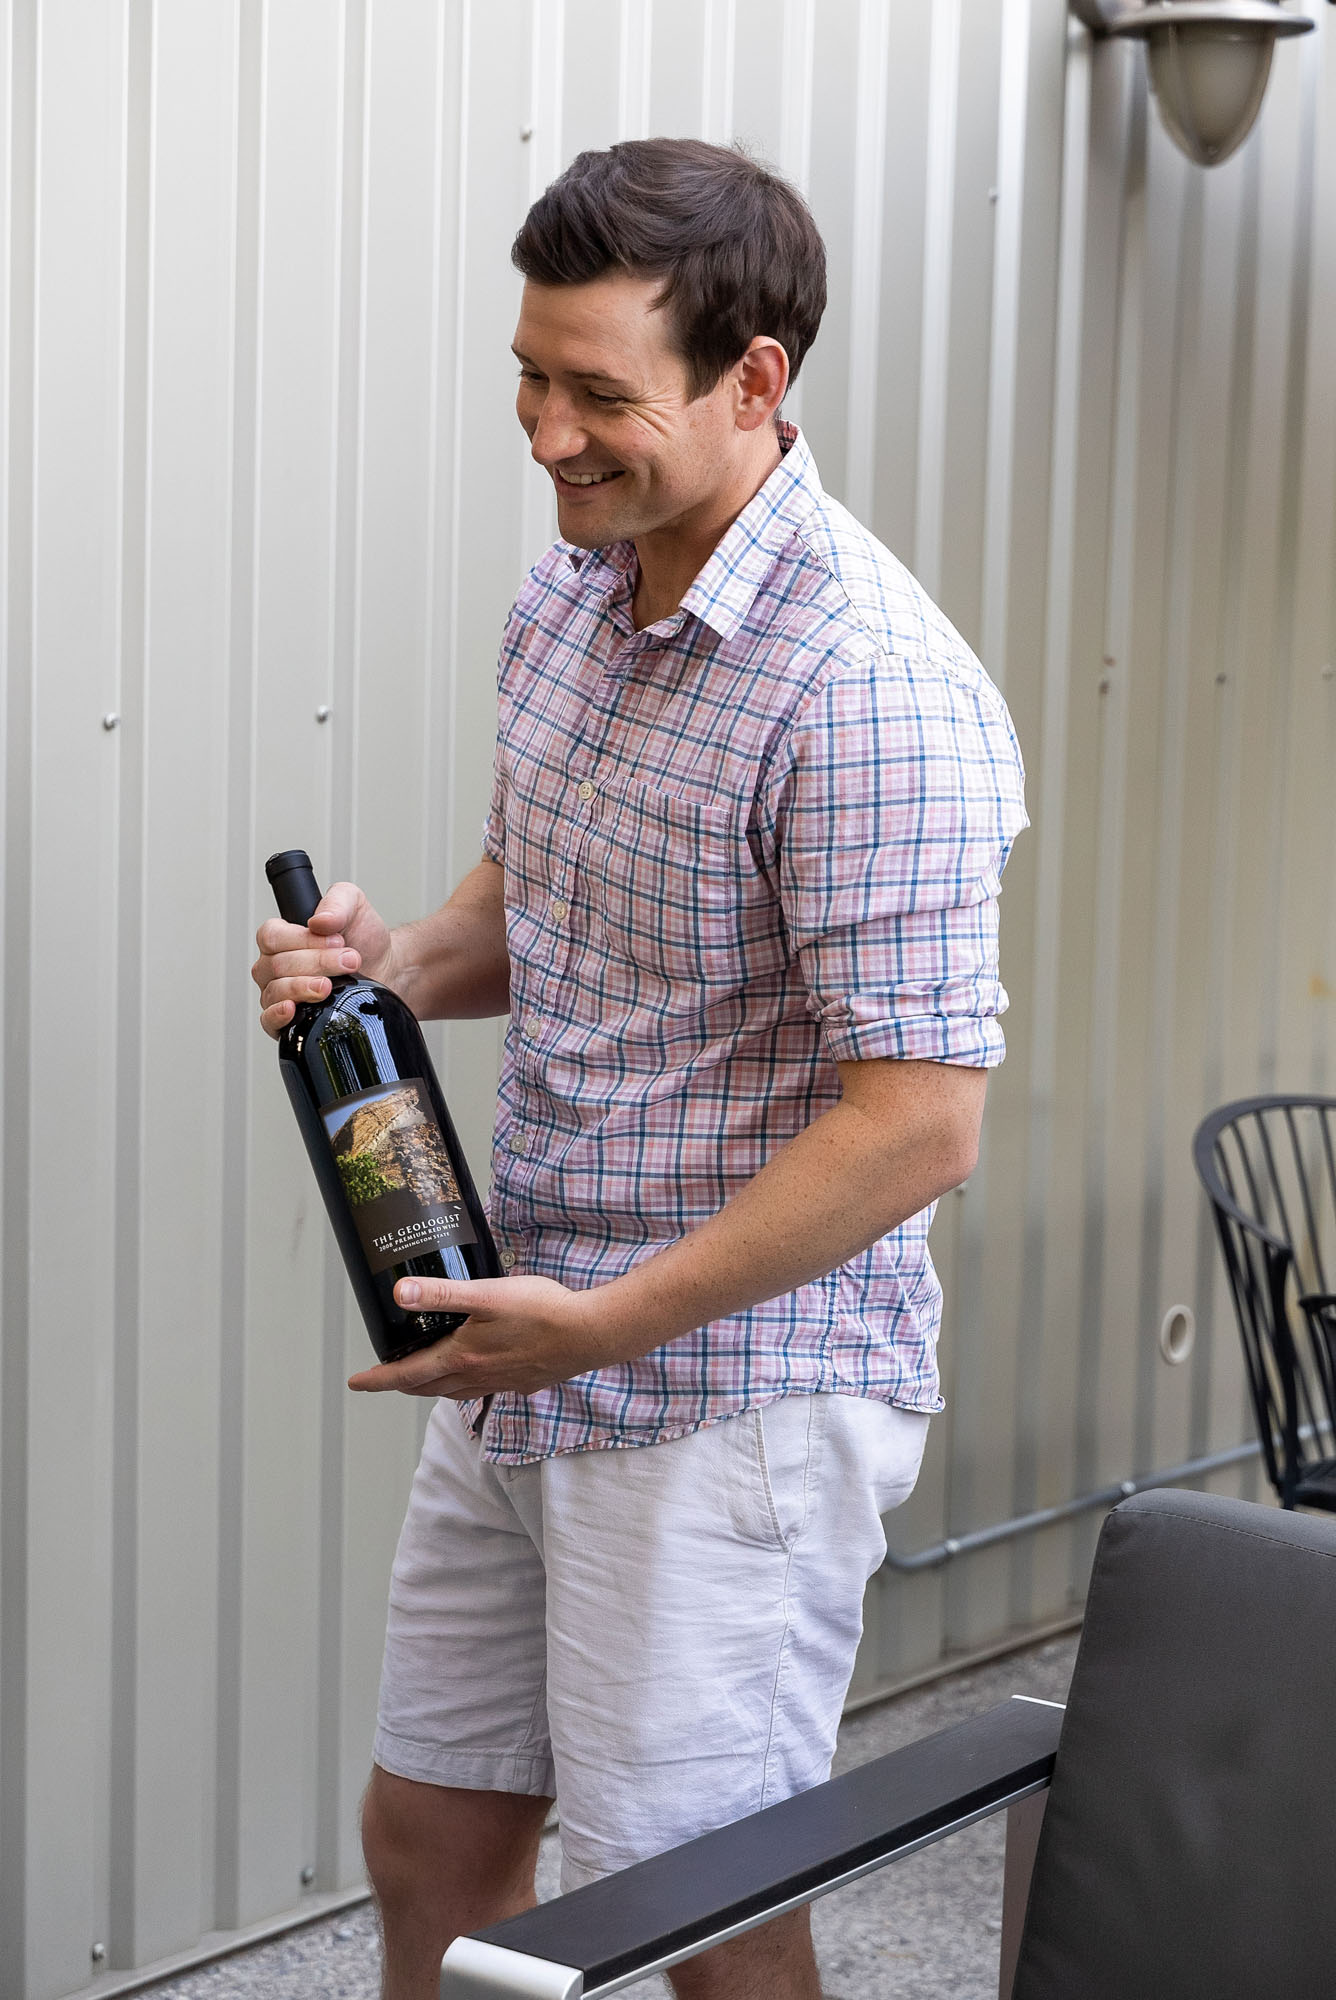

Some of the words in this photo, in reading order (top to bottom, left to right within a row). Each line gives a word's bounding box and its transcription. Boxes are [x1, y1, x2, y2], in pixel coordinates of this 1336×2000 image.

[373, 1232, 394, 1247] THE
[397, 1213, 460, 1236] GEOLOGIST
[395, 1231, 427, 1245] PREMIUM
[428, 1226, 442, 1234] RED
[441, 1222, 460, 1230] WINE
[393, 1236, 433, 1252] WASHINGTON
